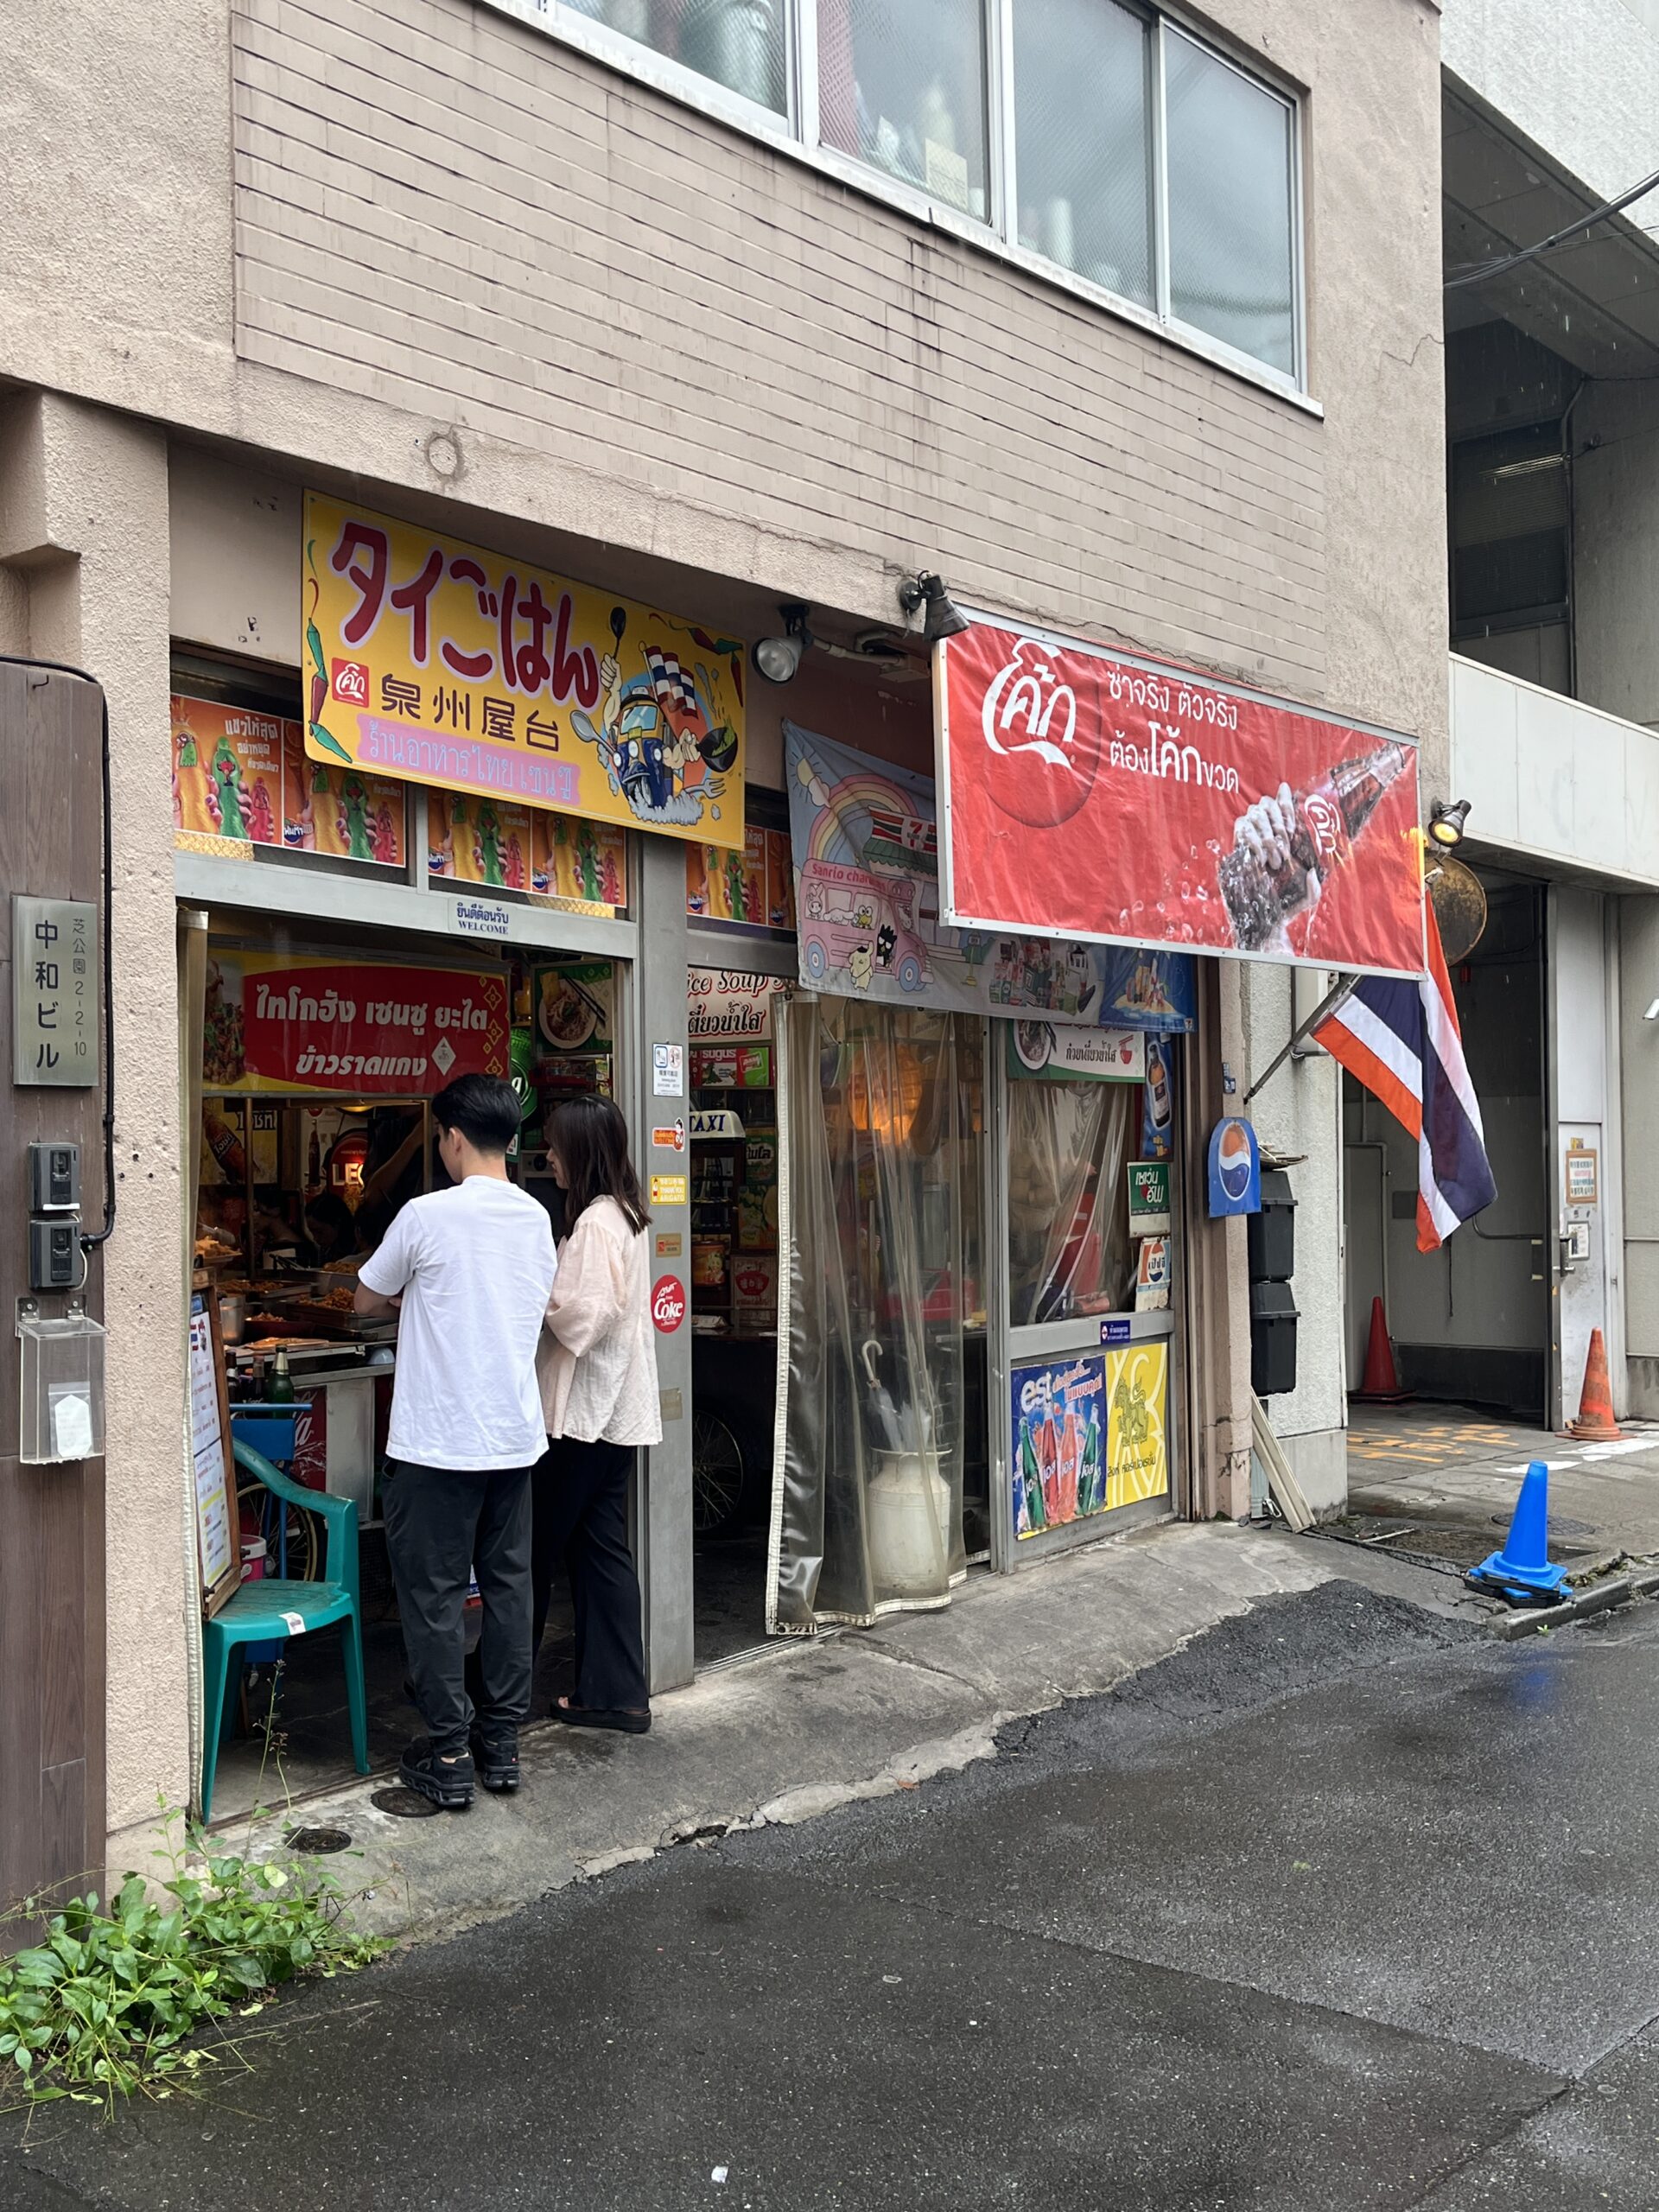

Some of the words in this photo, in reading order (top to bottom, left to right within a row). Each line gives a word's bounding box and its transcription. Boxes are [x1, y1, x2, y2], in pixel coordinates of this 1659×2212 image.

[331, 521, 601, 709] タイごはん
[381, 673, 559, 753] 泉州屋台
[1107, 664, 1170, 713] ซ่าจริง
[1178, 683, 1238, 731] ตัวจริง
[369, 720, 513, 790] ร้านอาหารไทย
[1109, 721, 1240, 794] ต้องโค้กขวด
[812, 863, 844, 880] Sanrio
[456, 902, 509, 925] ยินดีต้อนรับ
[458, 919, 509, 936] WELCOME
[35, 919, 60, 1069] 中和ビル
[687, 973, 710, 993] ice
[256, 983, 357, 1022] ไทโกฮัง
[435, 999, 489, 1031] ยะไต
[296, 1045, 428, 1077] ข้าวราดแกง
[702, 1048, 737, 1061] sugus
[654, 1298, 683, 1320] Coke
[1021, 1371, 1052, 1414] est
